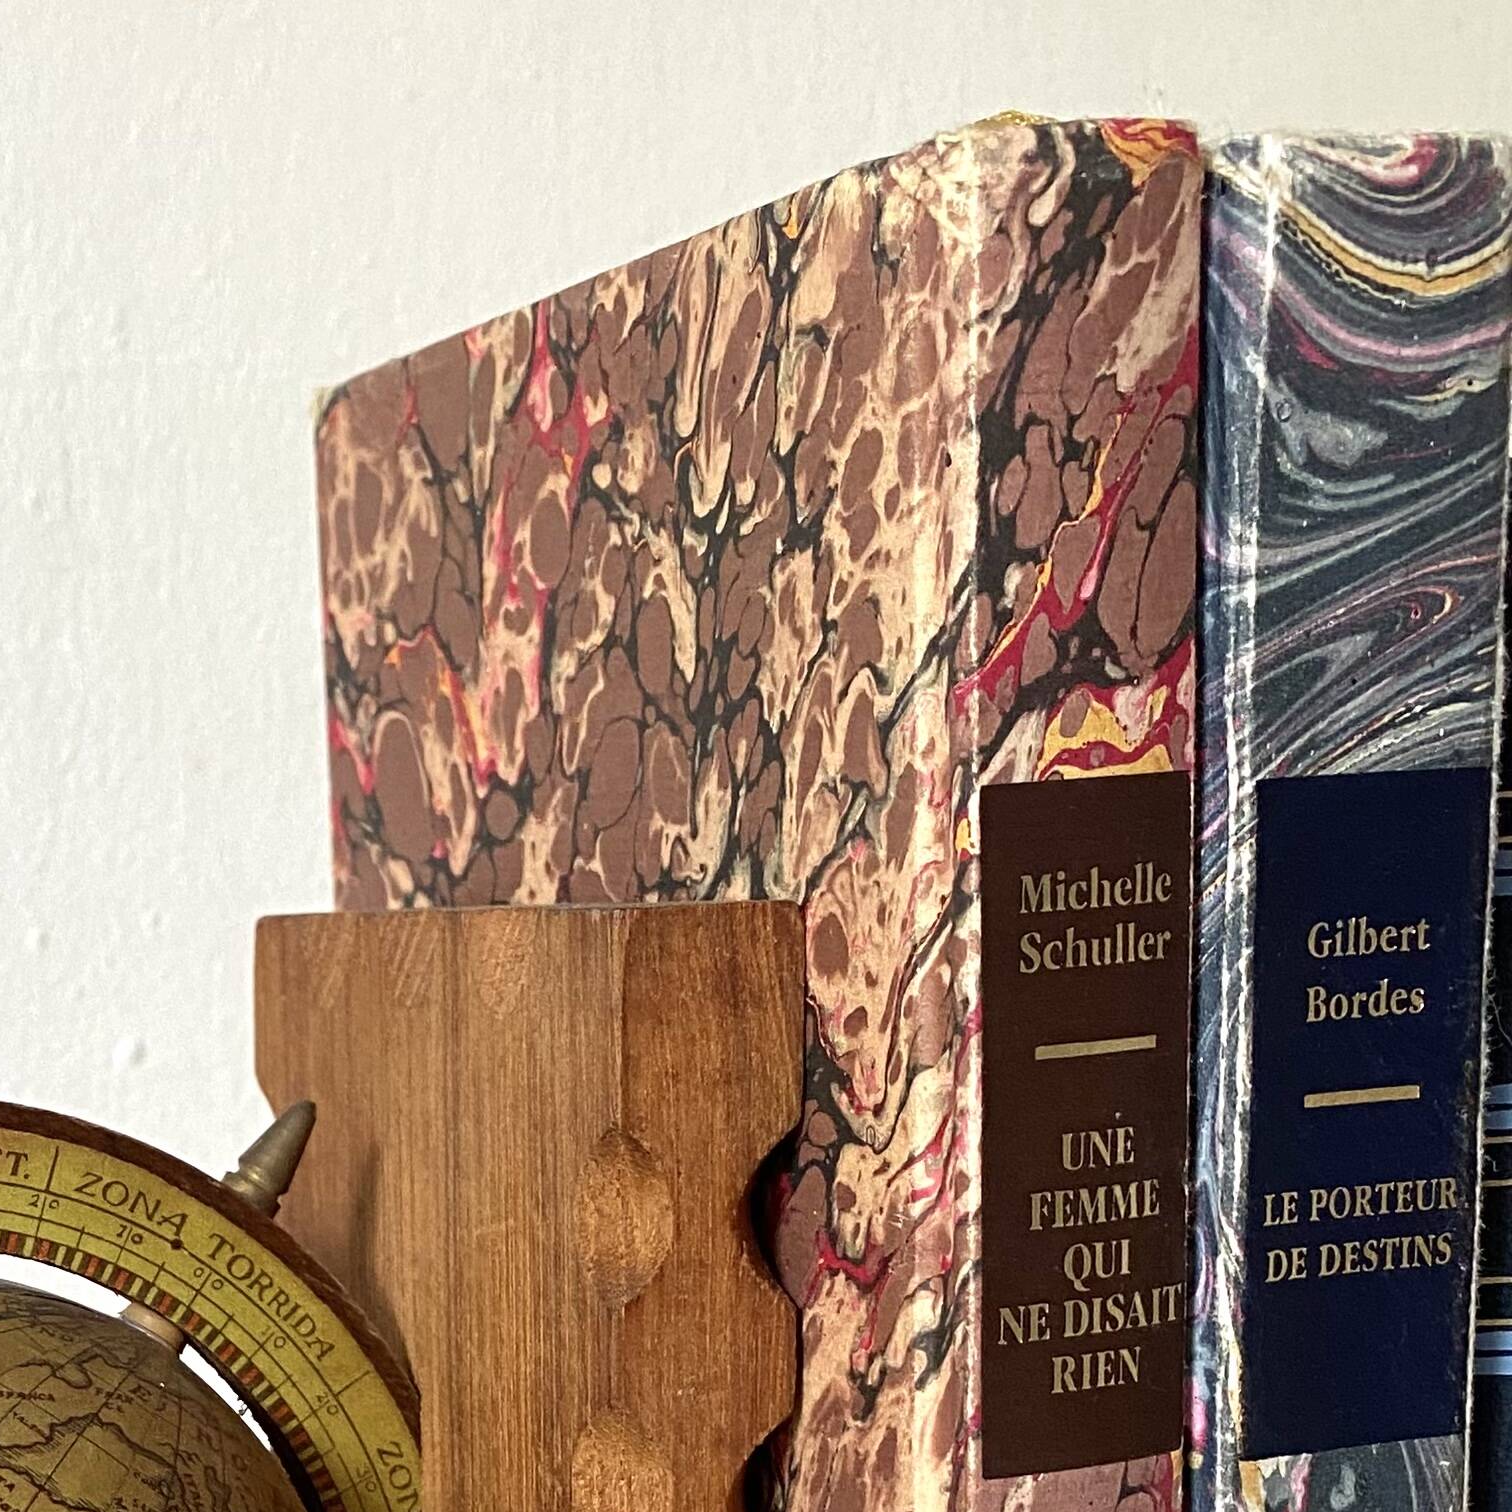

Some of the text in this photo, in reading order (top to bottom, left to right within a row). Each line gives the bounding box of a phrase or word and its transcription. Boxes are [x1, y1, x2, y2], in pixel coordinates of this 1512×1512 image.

[1019, 860, 1172, 915] Michelle
[1019, 921, 1172, 975] Schuller
[1306, 916, 1431, 961] Gilbert
[1306, 979, 1426, 1024] Bordes
[1061, 1126, 1137, 1172] UNE
[1029, 1178, 1161, 1232] FEMME
[1263, 1176, 1459, 1228] LE PORTEUR
[73, 1171, 337, 1363] ZONA TORRIDA
[1062, 1239, 1131, 1291] QUI
[1265, 1232, 1452, 1284] DE DESTINS
[997, 1285, 1185, 1347] NE DISAIT
[1050, 1346, 1143, 1395] RIEN
